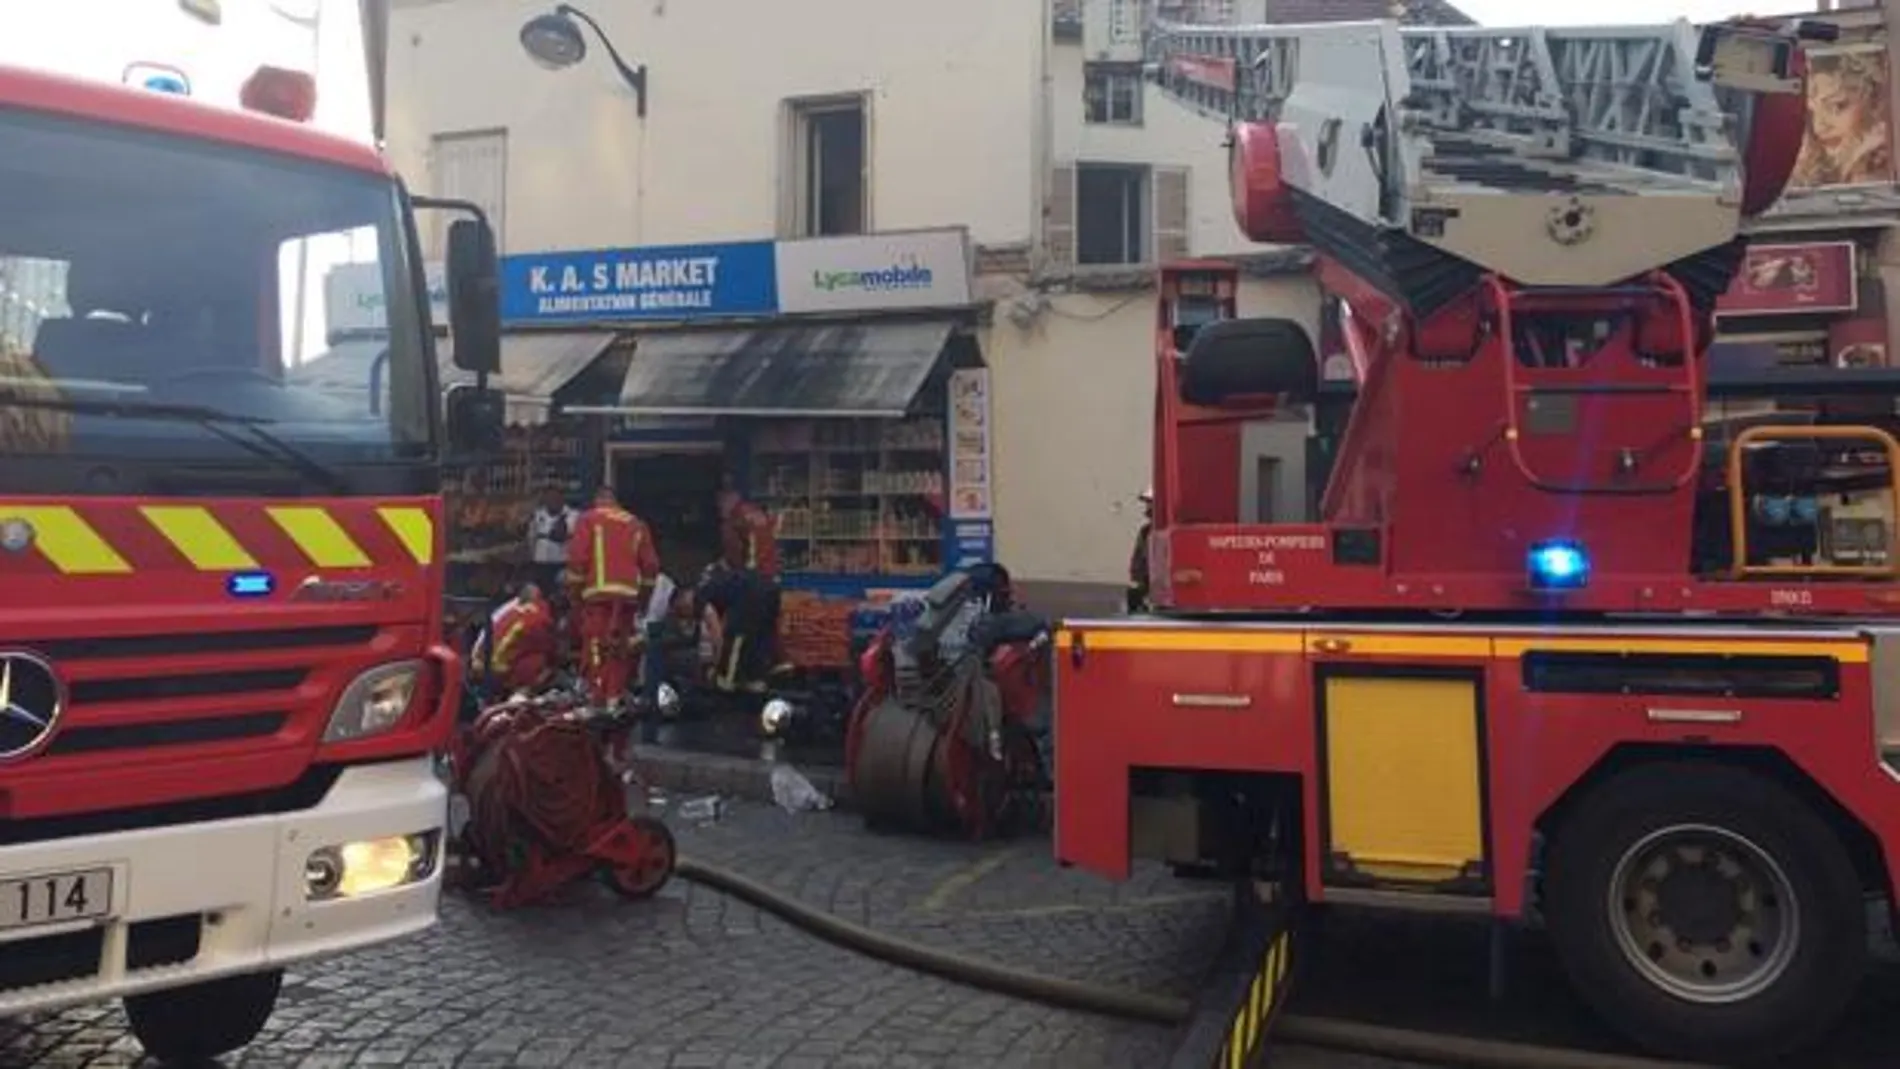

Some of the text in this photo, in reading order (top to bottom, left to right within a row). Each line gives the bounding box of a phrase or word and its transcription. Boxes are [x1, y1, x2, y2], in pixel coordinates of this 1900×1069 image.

[530, 257, 718, 293] K. A. S MARKET
[18, 875, 88, 920] 114
